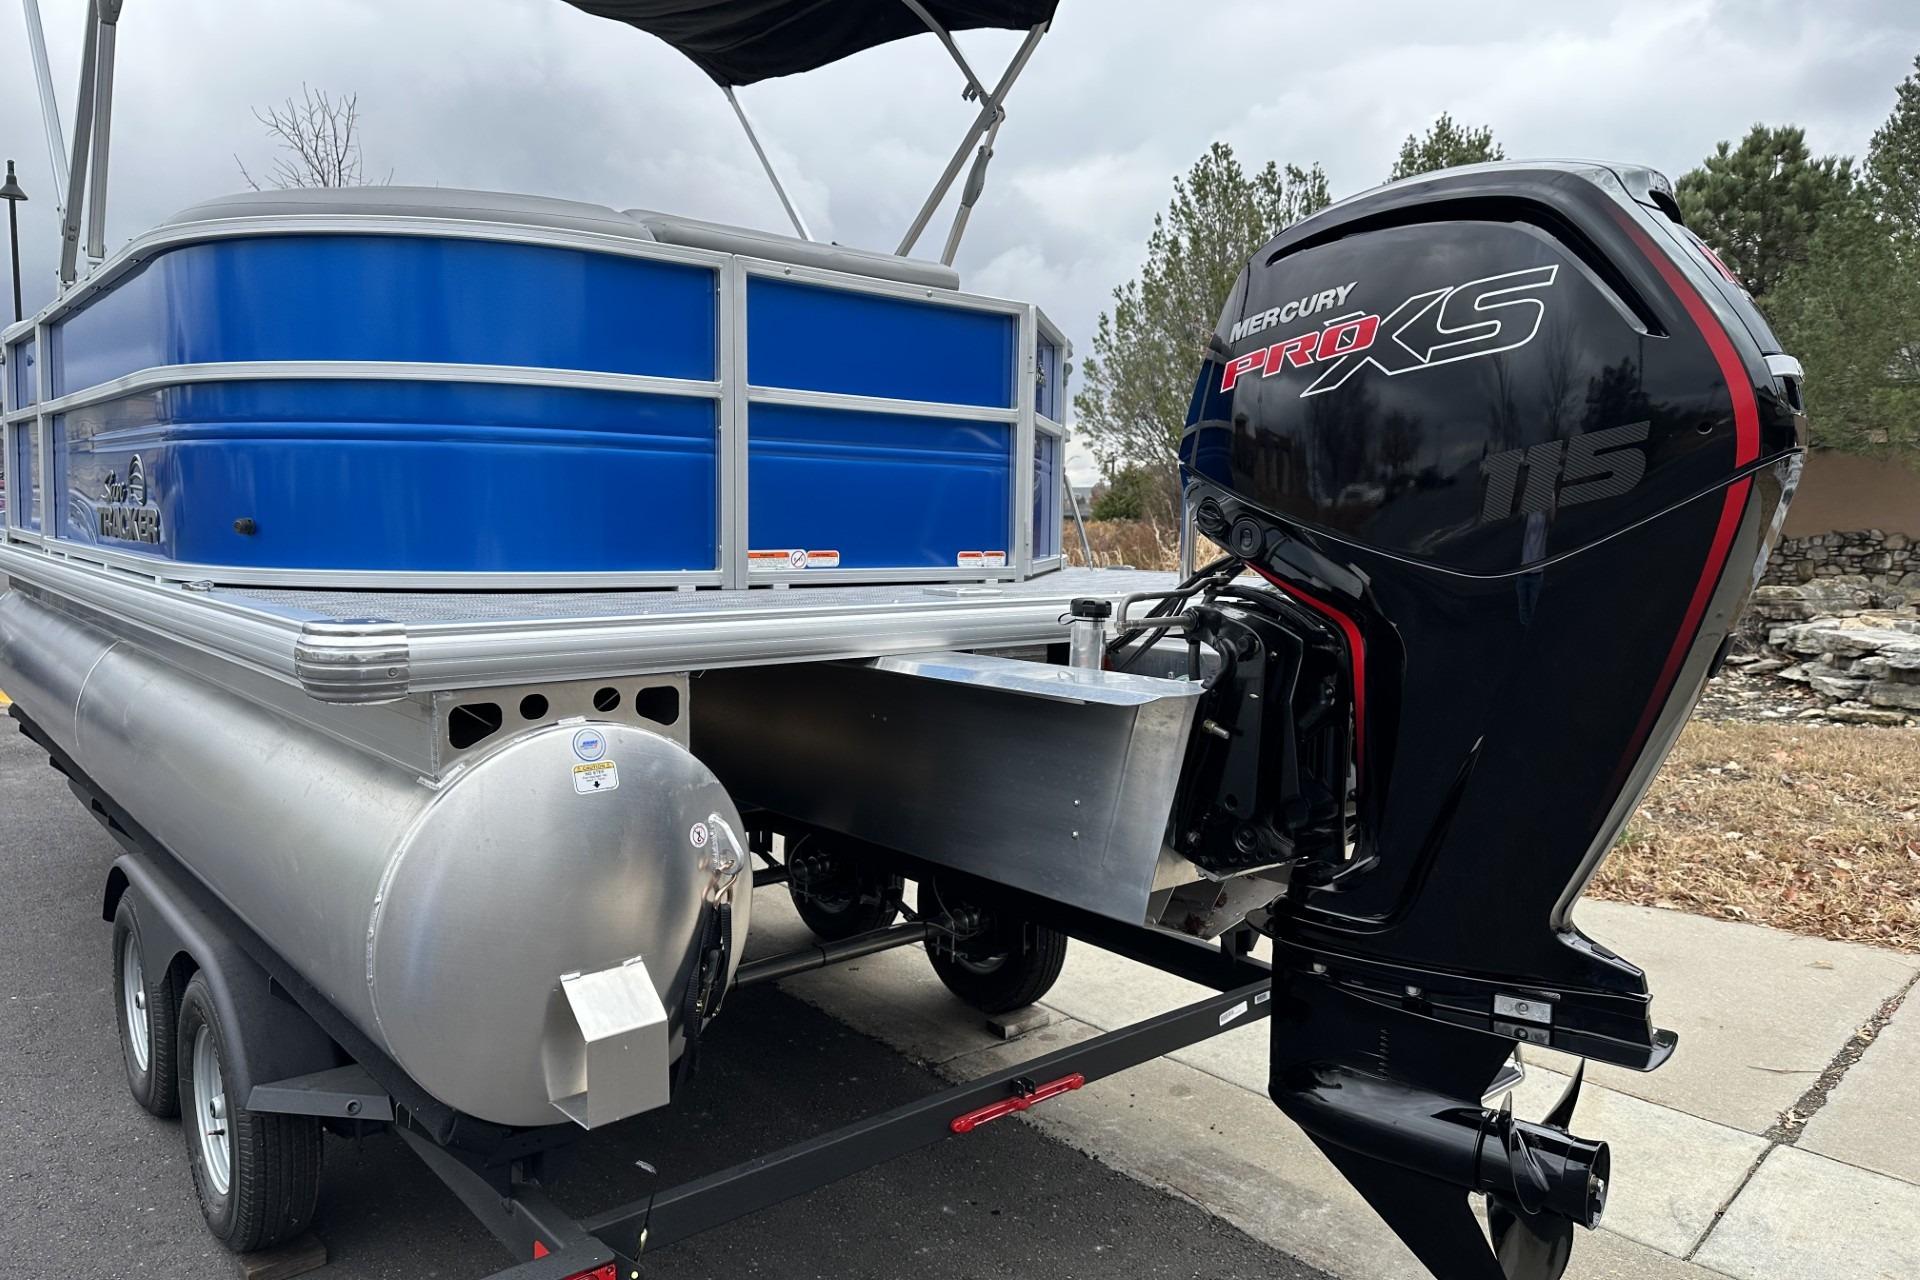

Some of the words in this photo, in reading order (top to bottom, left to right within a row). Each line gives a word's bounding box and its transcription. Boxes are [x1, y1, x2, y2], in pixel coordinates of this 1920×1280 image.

[1229, 281, 1358, 344] MERCURY
[1300, 264, 1559, 398] XS
[1220, 314, 1381, 393] PRO
[1481, 421, 1652, 523] 115
[96, 505, 161, 545] TRACKER
